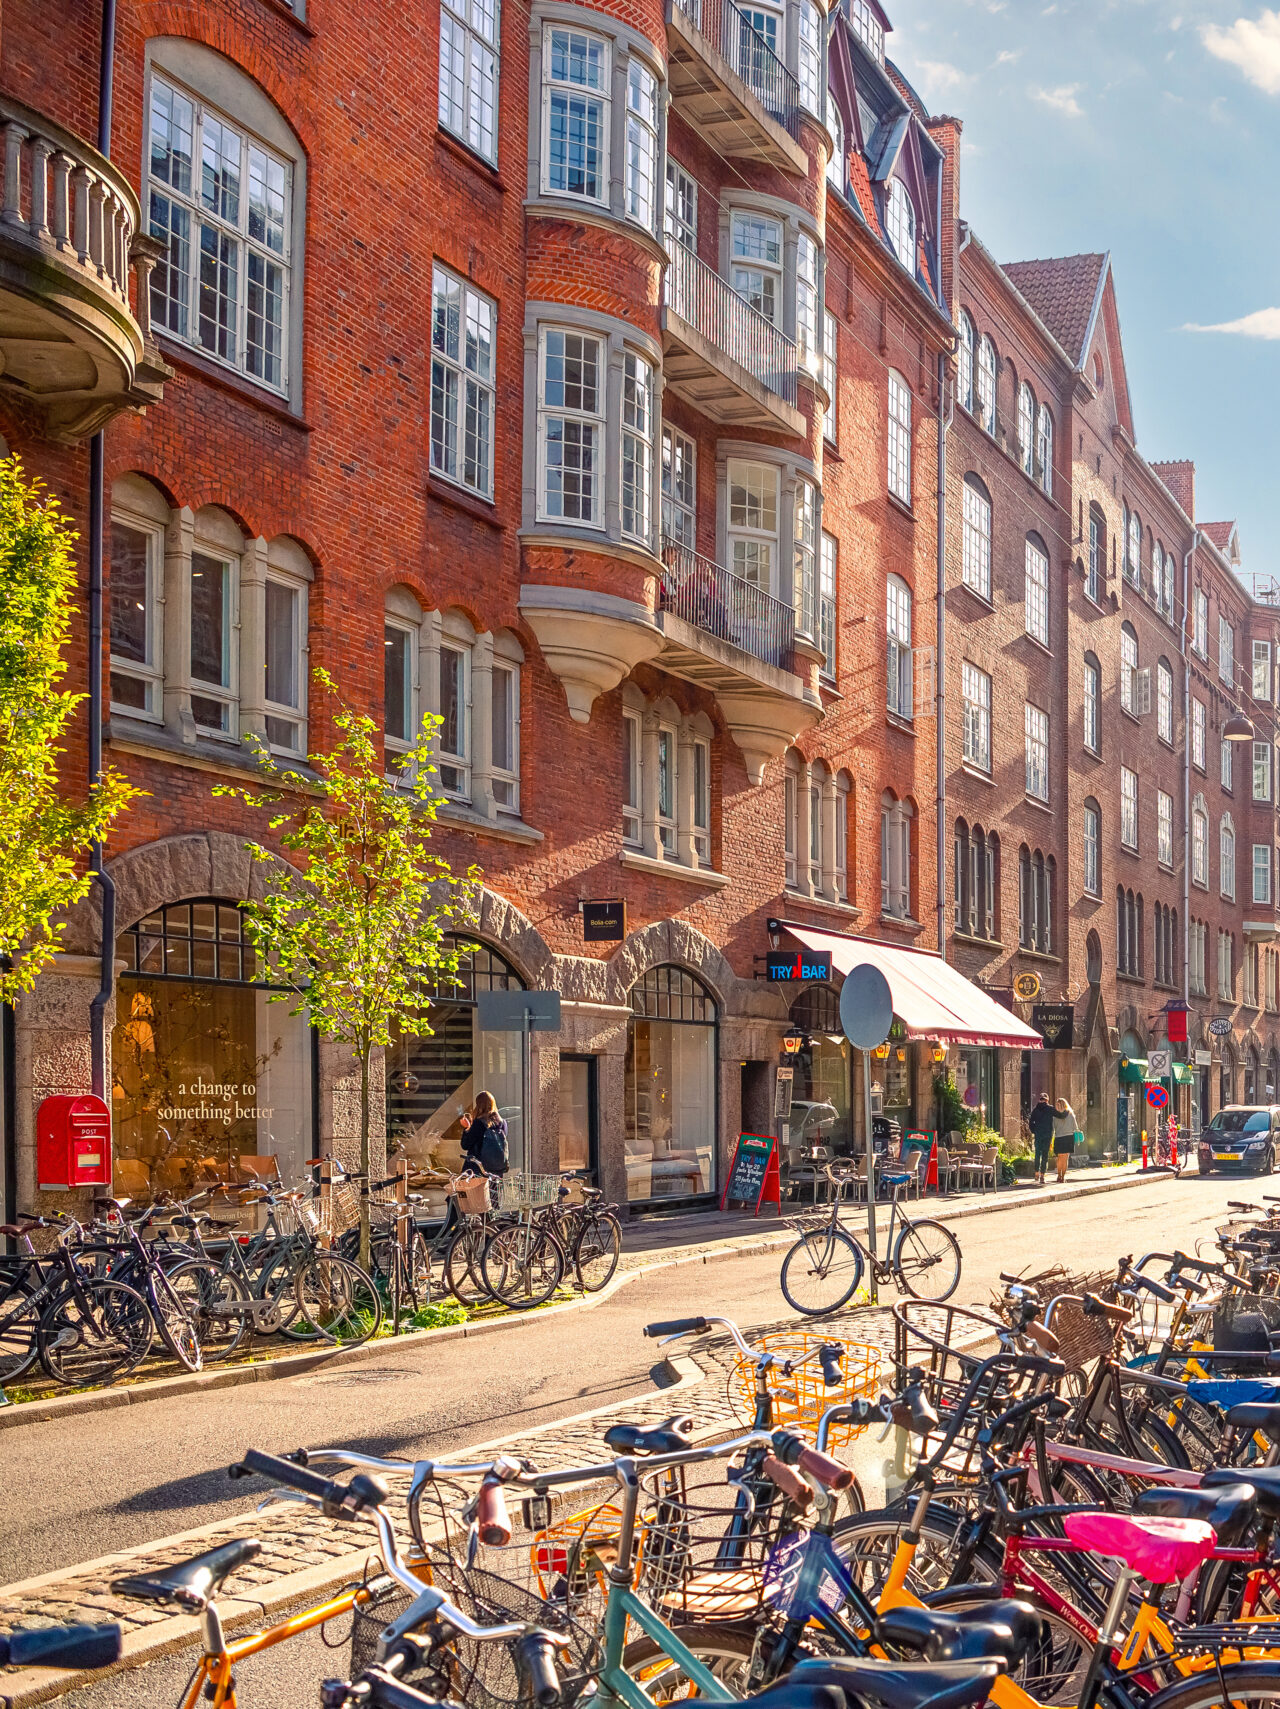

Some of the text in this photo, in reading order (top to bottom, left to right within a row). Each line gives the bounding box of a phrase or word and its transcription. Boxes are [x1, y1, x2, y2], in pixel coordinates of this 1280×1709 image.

[178, 1076, 256, 1101] a change to
[157, 1101, 275, 1126] something better
[12, 1287, 49, 1320] RALEIGH
[1060, 1604, 1081, 1627] WORK
